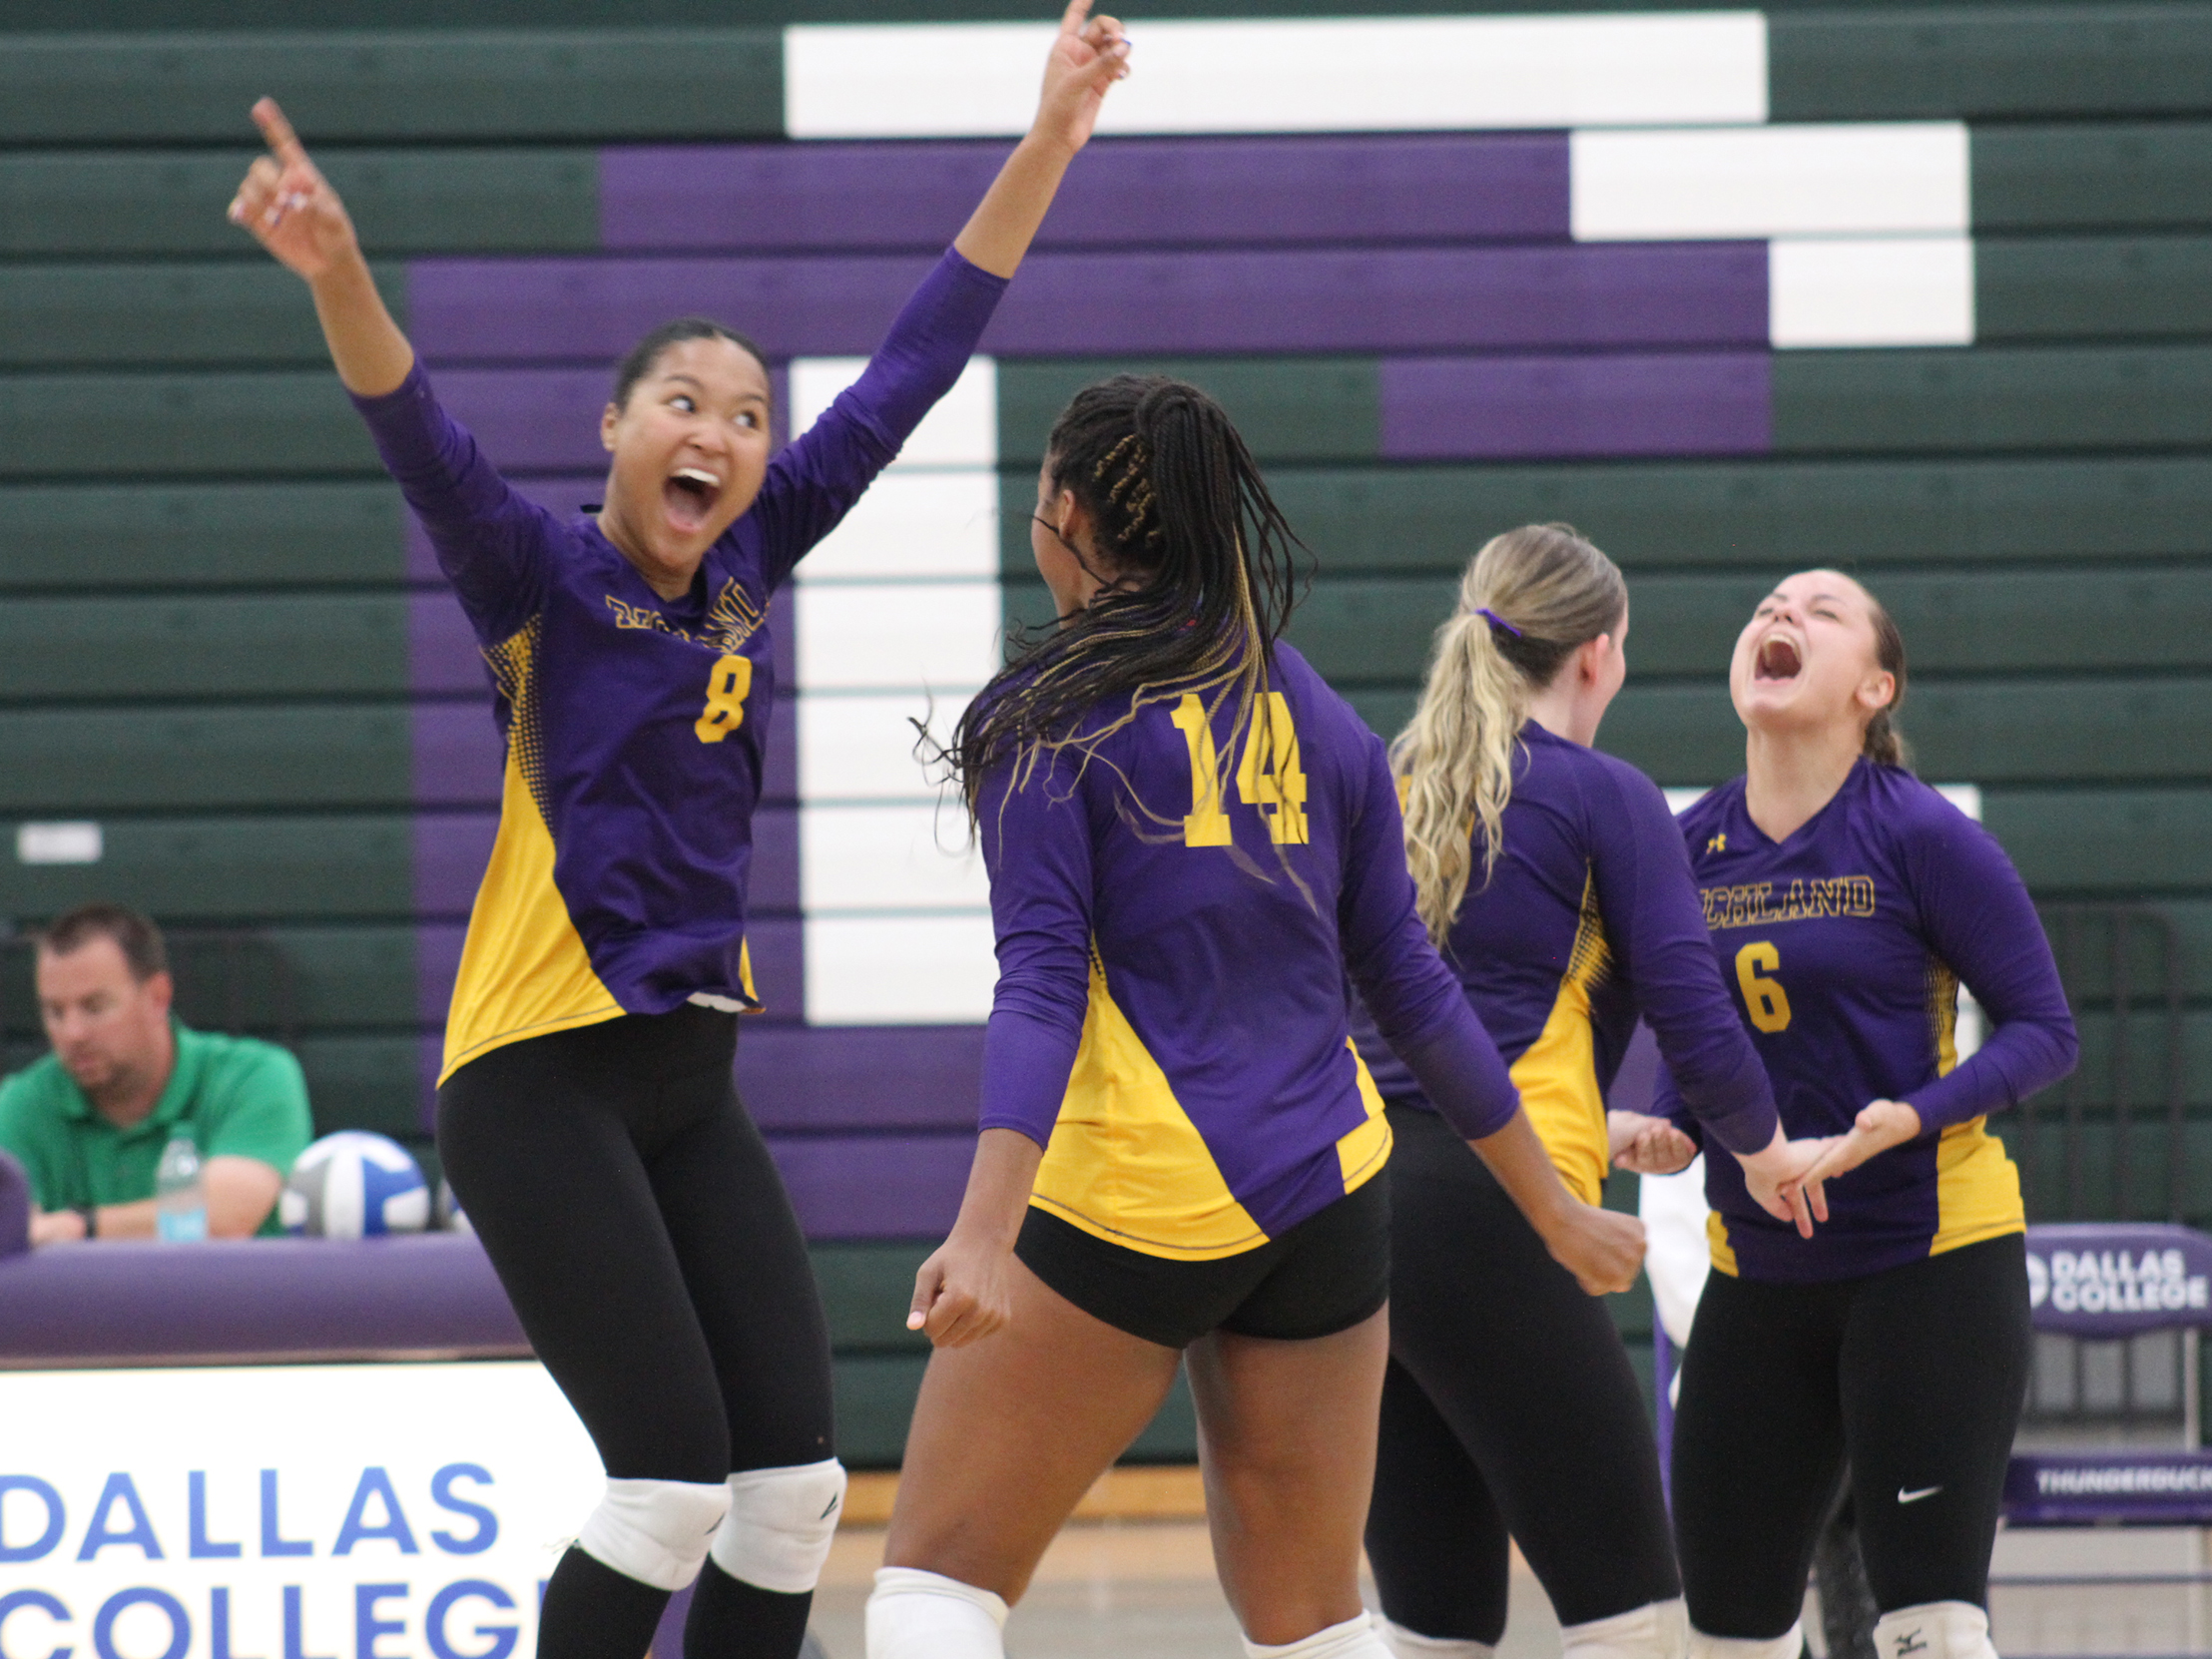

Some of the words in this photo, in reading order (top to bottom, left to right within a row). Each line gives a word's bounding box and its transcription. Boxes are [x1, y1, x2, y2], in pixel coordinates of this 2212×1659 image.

[695, 654, 753, 744] 8
[1170, 692, 1310, 847] 14
[1700, 875, 1875, 930] CHLAND
[1735, 940, 1792, 1034] 6
[2051, 1249, 2185, 1280] DALLAS
[2051, 1276, 2208, 1314] COLLEGE
[0, 1463, 498, 1563] DALLAS
